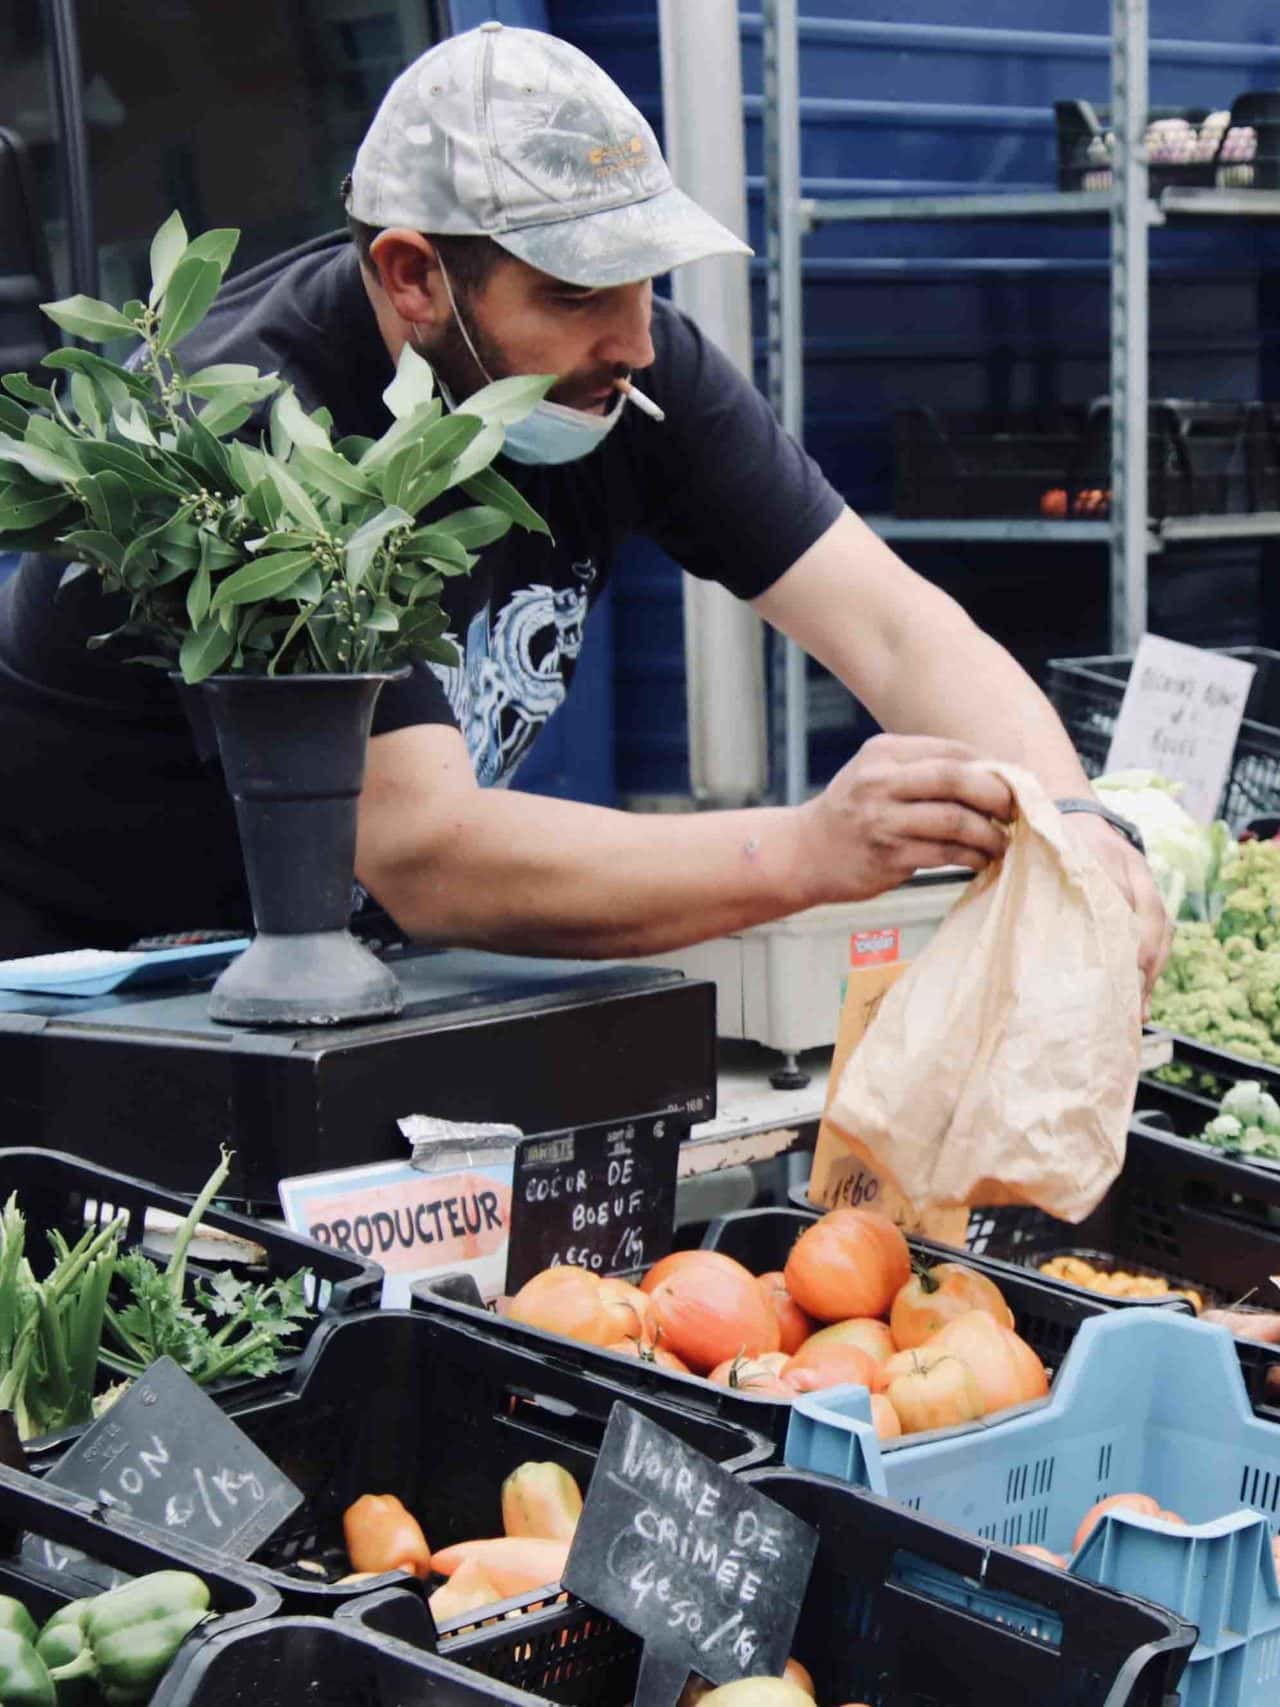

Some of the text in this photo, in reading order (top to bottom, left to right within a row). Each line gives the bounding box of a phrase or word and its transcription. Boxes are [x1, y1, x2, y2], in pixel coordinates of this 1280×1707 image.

[607, 1159, 634, 1187] DE
[310, 1190, 503, 1257] PRODUCTEUR
[571, 1190, 644, 1231] BOEUF
[733, 1510, 783, 1560] DE
